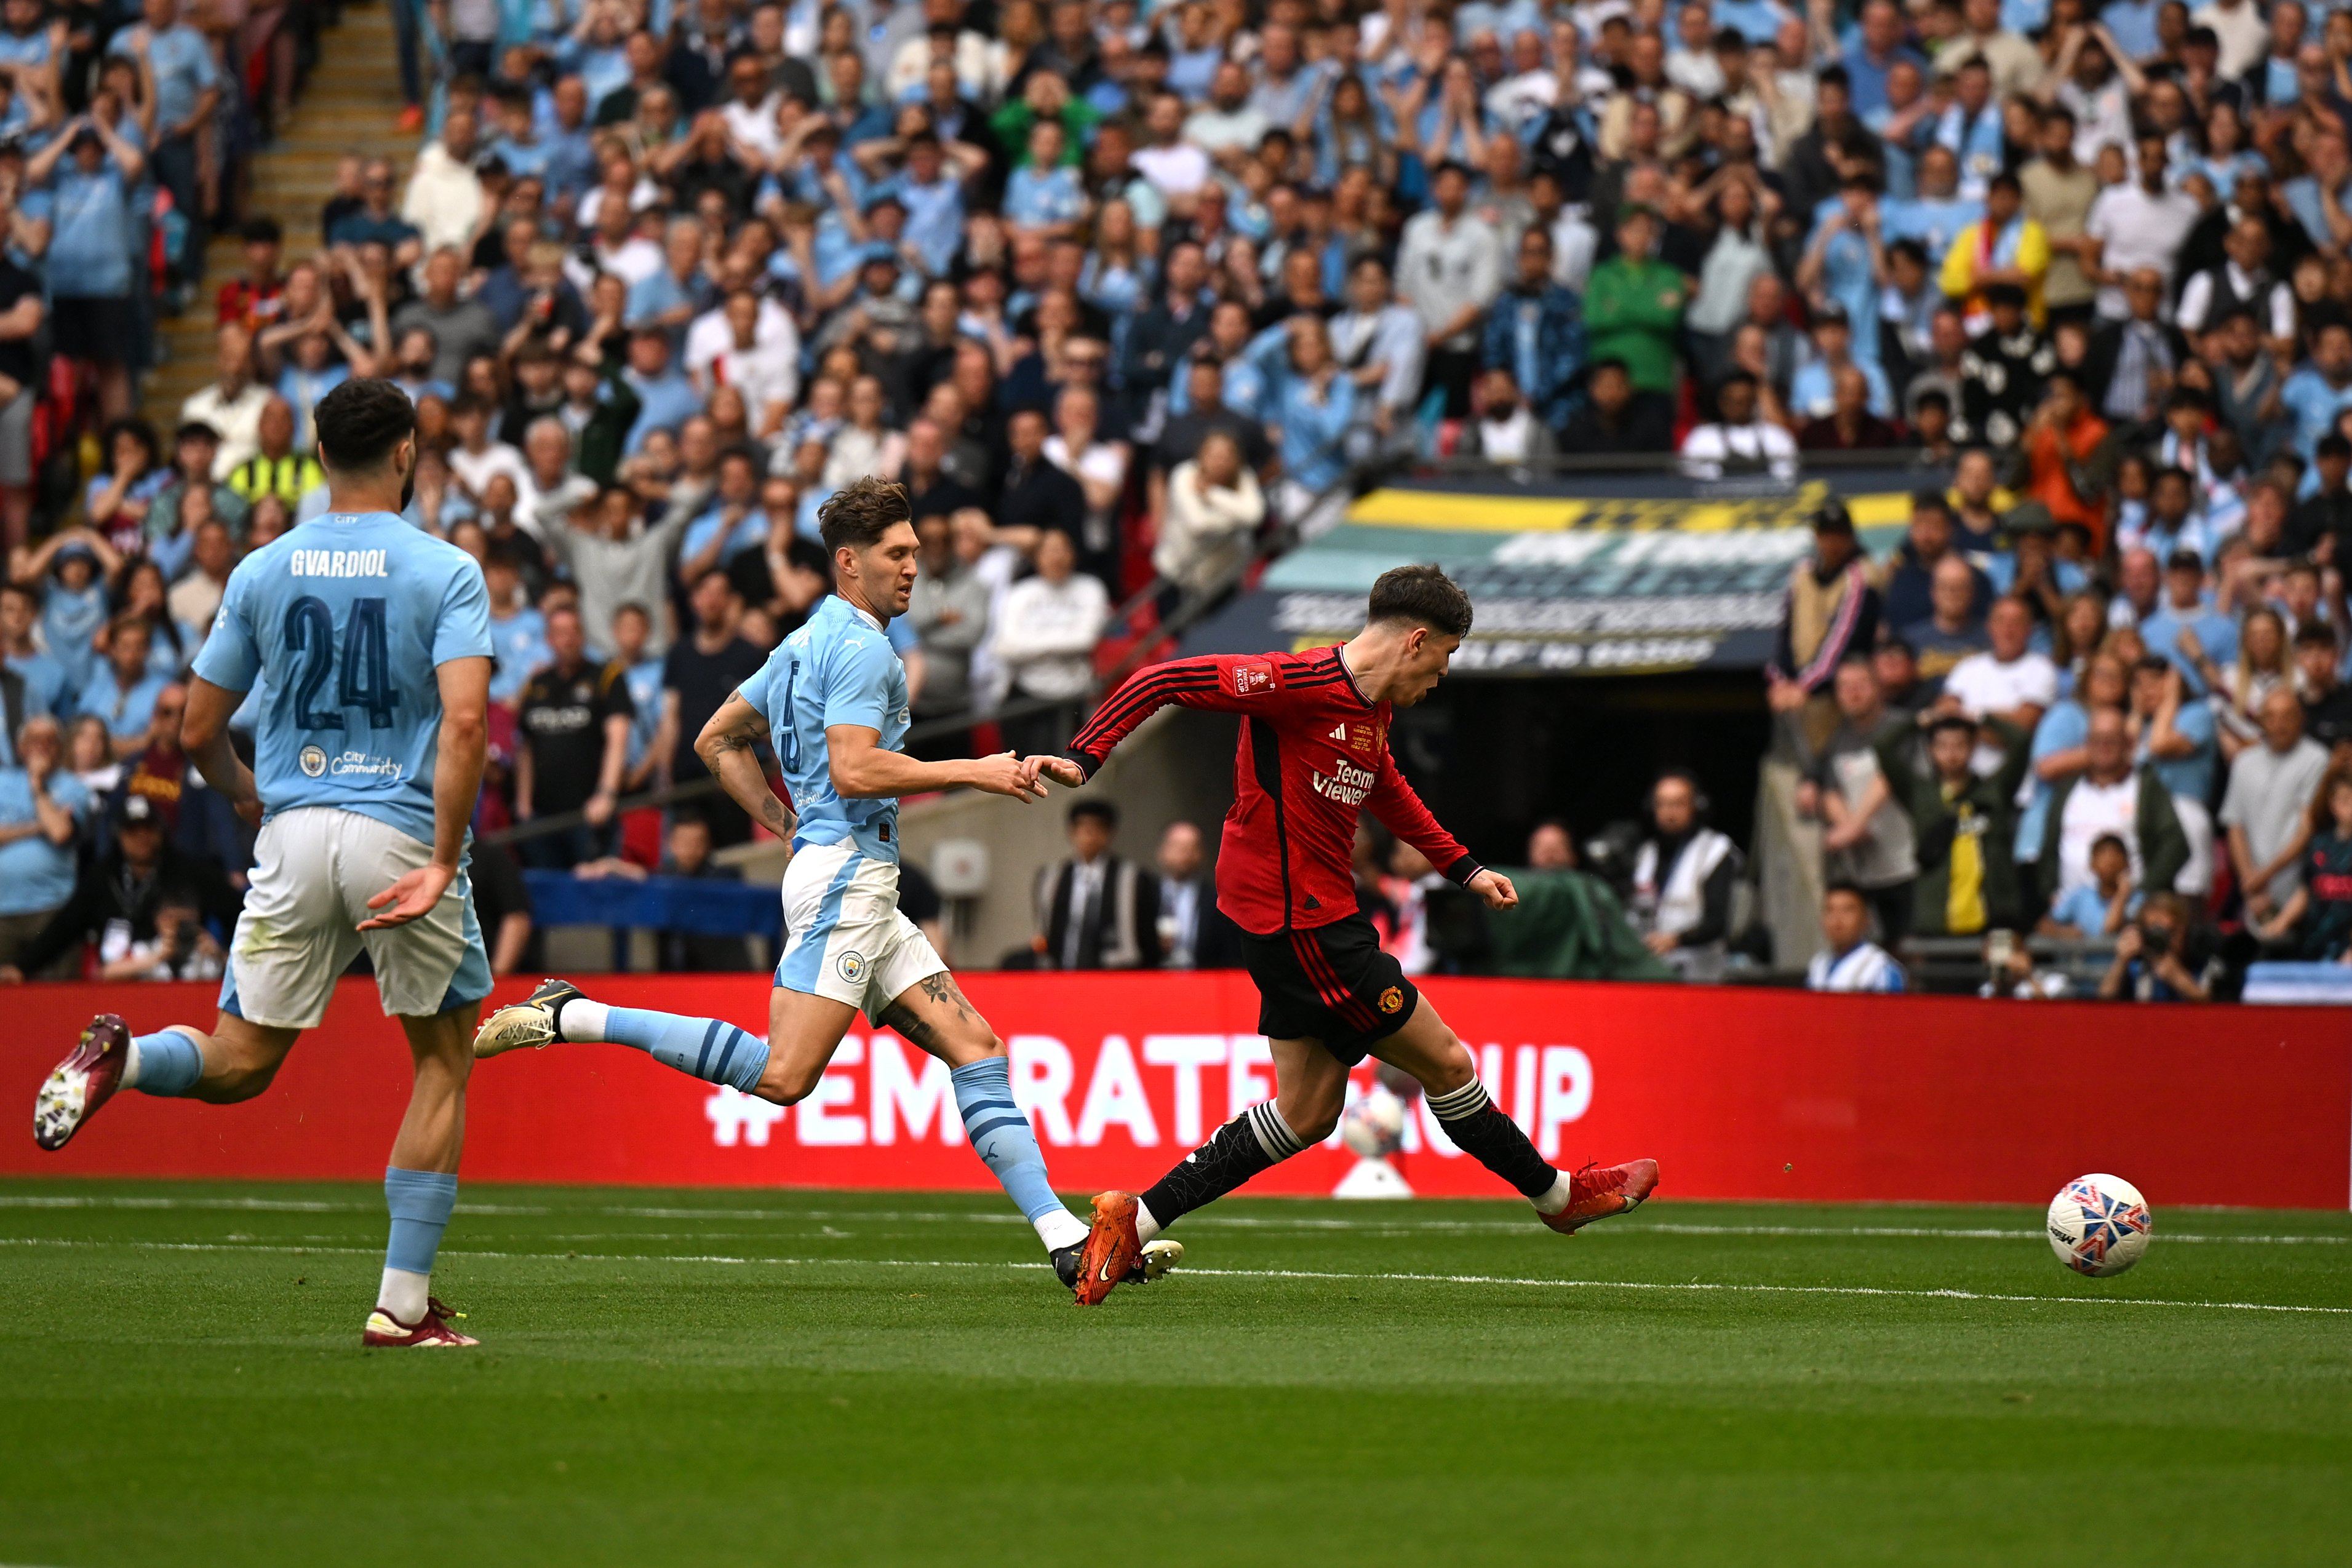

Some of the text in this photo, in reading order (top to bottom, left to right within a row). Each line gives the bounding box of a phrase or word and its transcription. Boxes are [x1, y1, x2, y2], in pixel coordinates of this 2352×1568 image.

[291, 549, 388, 577] GVARDIOL
[284, 595, 399, 730] 24
[1237, 669, 1243, 678] FA
[331, 757, 402, 780] Community
[343, 751, 366, 764] City
[1336, 759, 1374, 789] Team
[1314, 771, 1371, 806] Viewer
